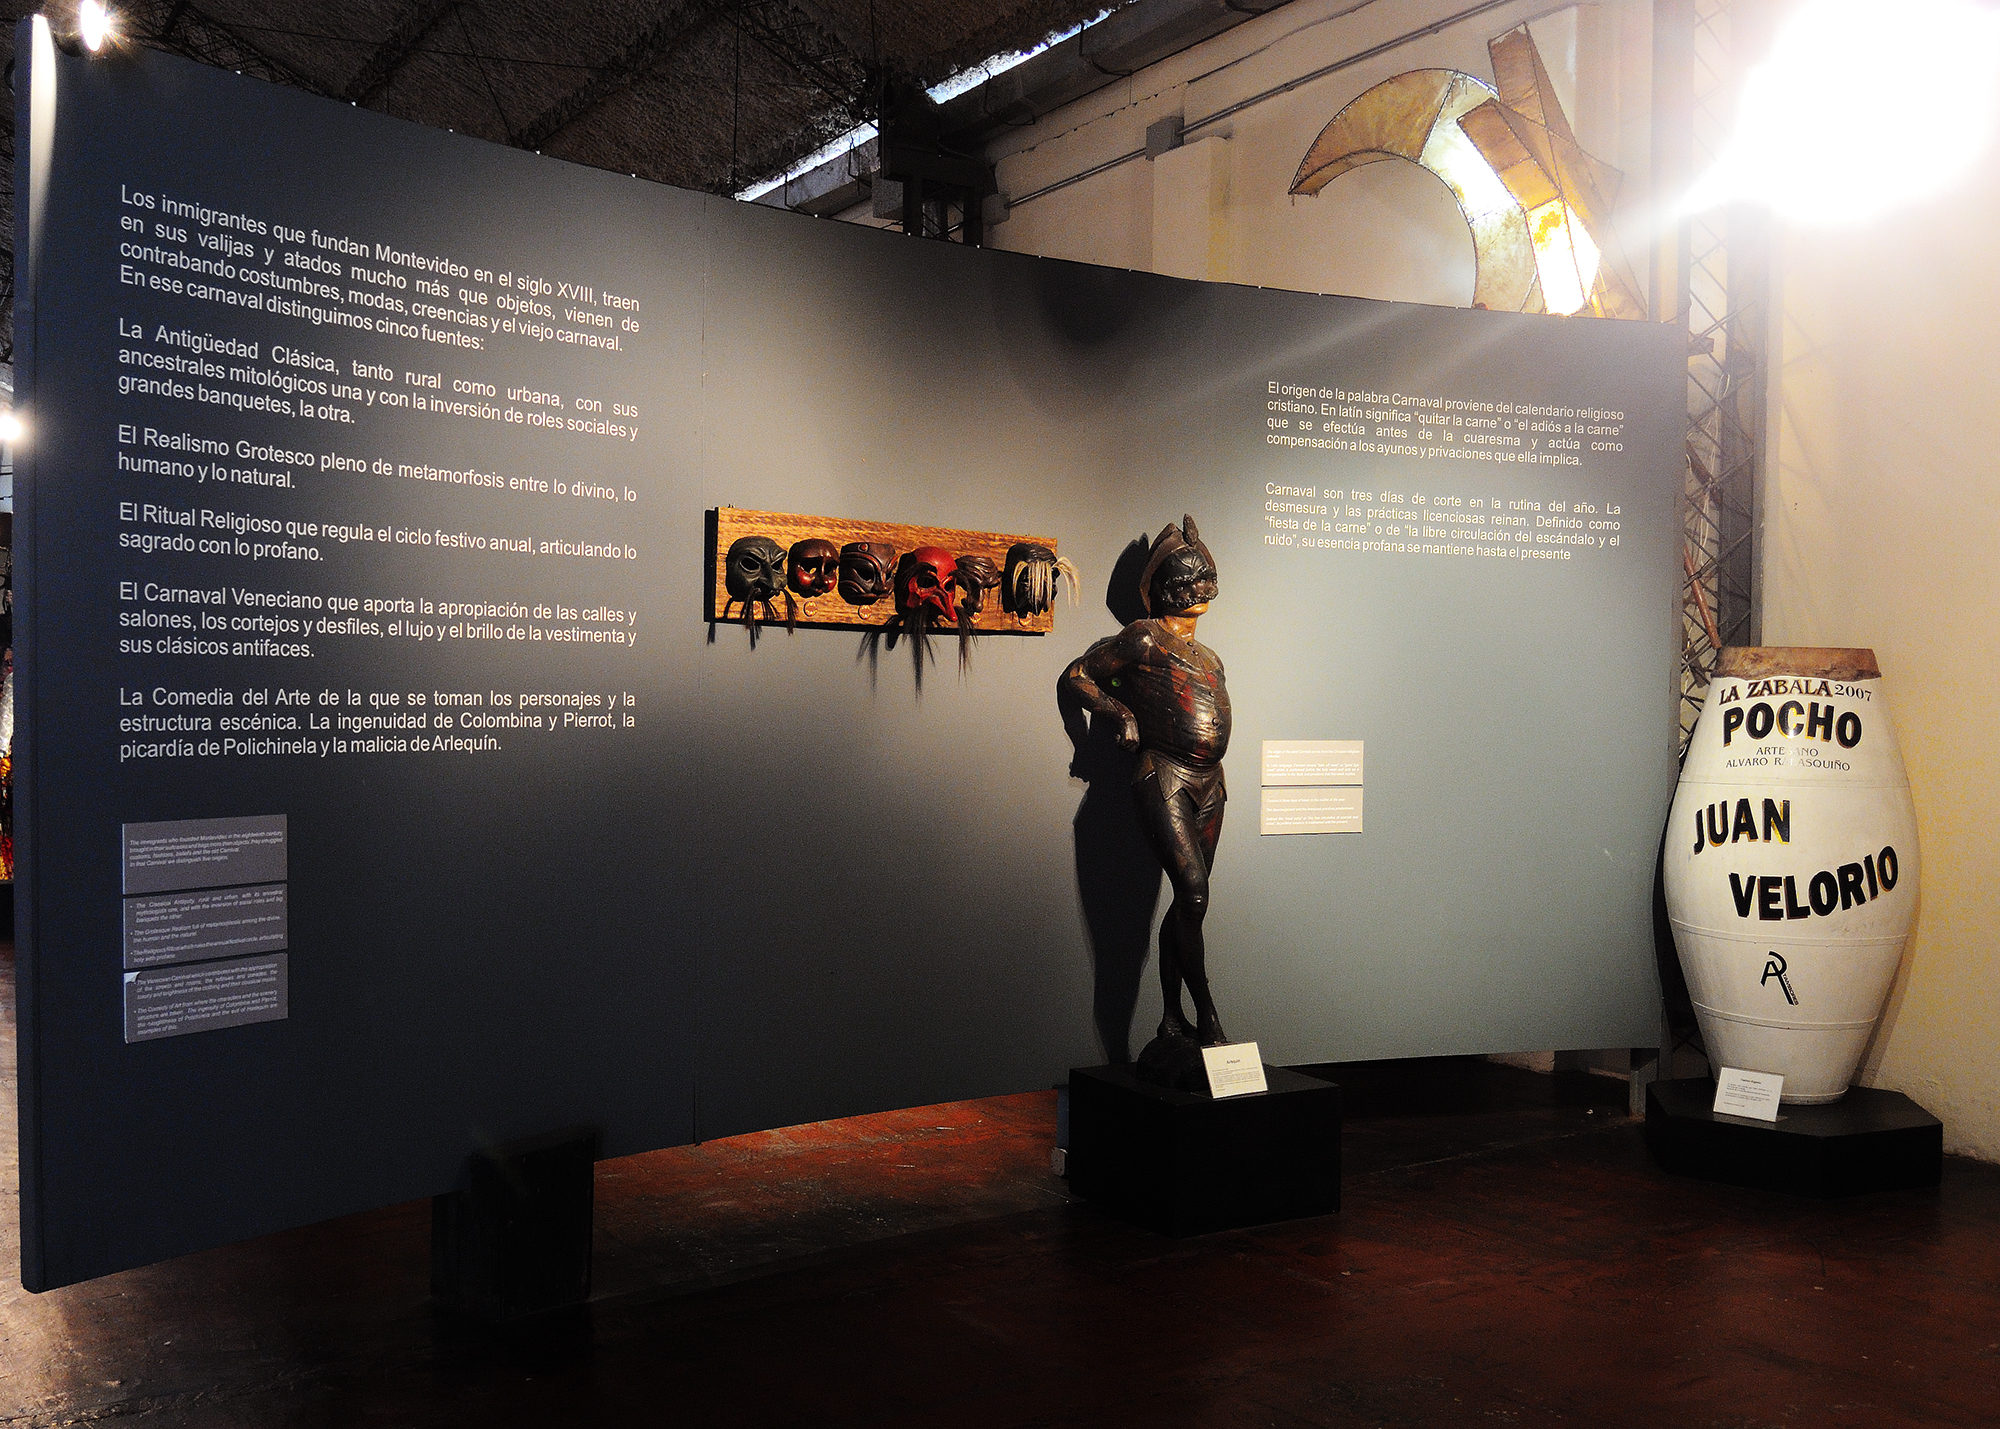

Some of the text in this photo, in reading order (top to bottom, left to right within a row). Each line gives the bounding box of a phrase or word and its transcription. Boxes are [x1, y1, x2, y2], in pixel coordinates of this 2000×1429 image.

[121, 183, 640, 312] Los inmigrantes que fundan Montevideo en el siglo XVIII, traen
[120, 215, 640, 333] en sus valijas y atados mucho más que objetos, vienen de
[119, 242, 623, 352] contrabando costumbres, modas, creencias y el viejo carnaval.
[120, 263, 484, 351] En ese carnaval distinguimos cinco fuentes:
[1267, 398, 1318, 415] cristiano.
[1320, 402, 1336, 416] En
[1338, 404, 1363, 419] latín
[1365, 408, 1412, 423] significa
[1452, 414, 1463, 426] la
[1503, 420, 1512, 430] o
[1530, 420, 1562, 433] adiós
[1564, 424, 1572, 434] a
[1574, 422, 1584, 434] la
[1268, 380, 1624, 422] El origen de la palabra Carnaval proviene del calendario religioso
[1266, 417, 1624, 452] que se efectúa antes de la cuaresma y actúa como
[1266, 434, 1583, 467] compensación a los ayunos y privaciones que ella implica.
[118, 532, 324, 562] sagrado con lo profano.
[119, 501, 637, 560] El Ritual Religioso que regula el ciclo festivo anual, articulando lo
[1302, 537, 1316, 548] su
[1317, 538, 1360, 550] esencia
[1362, 539, 1405, 553] profana
[1406, 543, 1421, 553] se
[1422, 543, 1474, 556] mantiene
[1476, 544, 1507, 558] hasta
[1508, 546, 1519, 558] el
[1520, 548, 1571, 561] presente
[120, 686, 636, 711] La Comedia del Arte de la que se toman los personajes y la
[1719, 679, 1872, 706] LA ZABALA 2007
[119, 711, 636, 734] estructura escénica. La ingenuidad de Colombina y Pierrot, la
[1723, 700, 1863, 749] POCHO
[119, 733, 502, 763] picardía de Polichinela y la malicia de Arlequín.
[1725, 757, 1769, 768] ALVARO
[1693, 798, 1791, 855] JUAN
[1728, 845, 1899, 921] VELORIO
